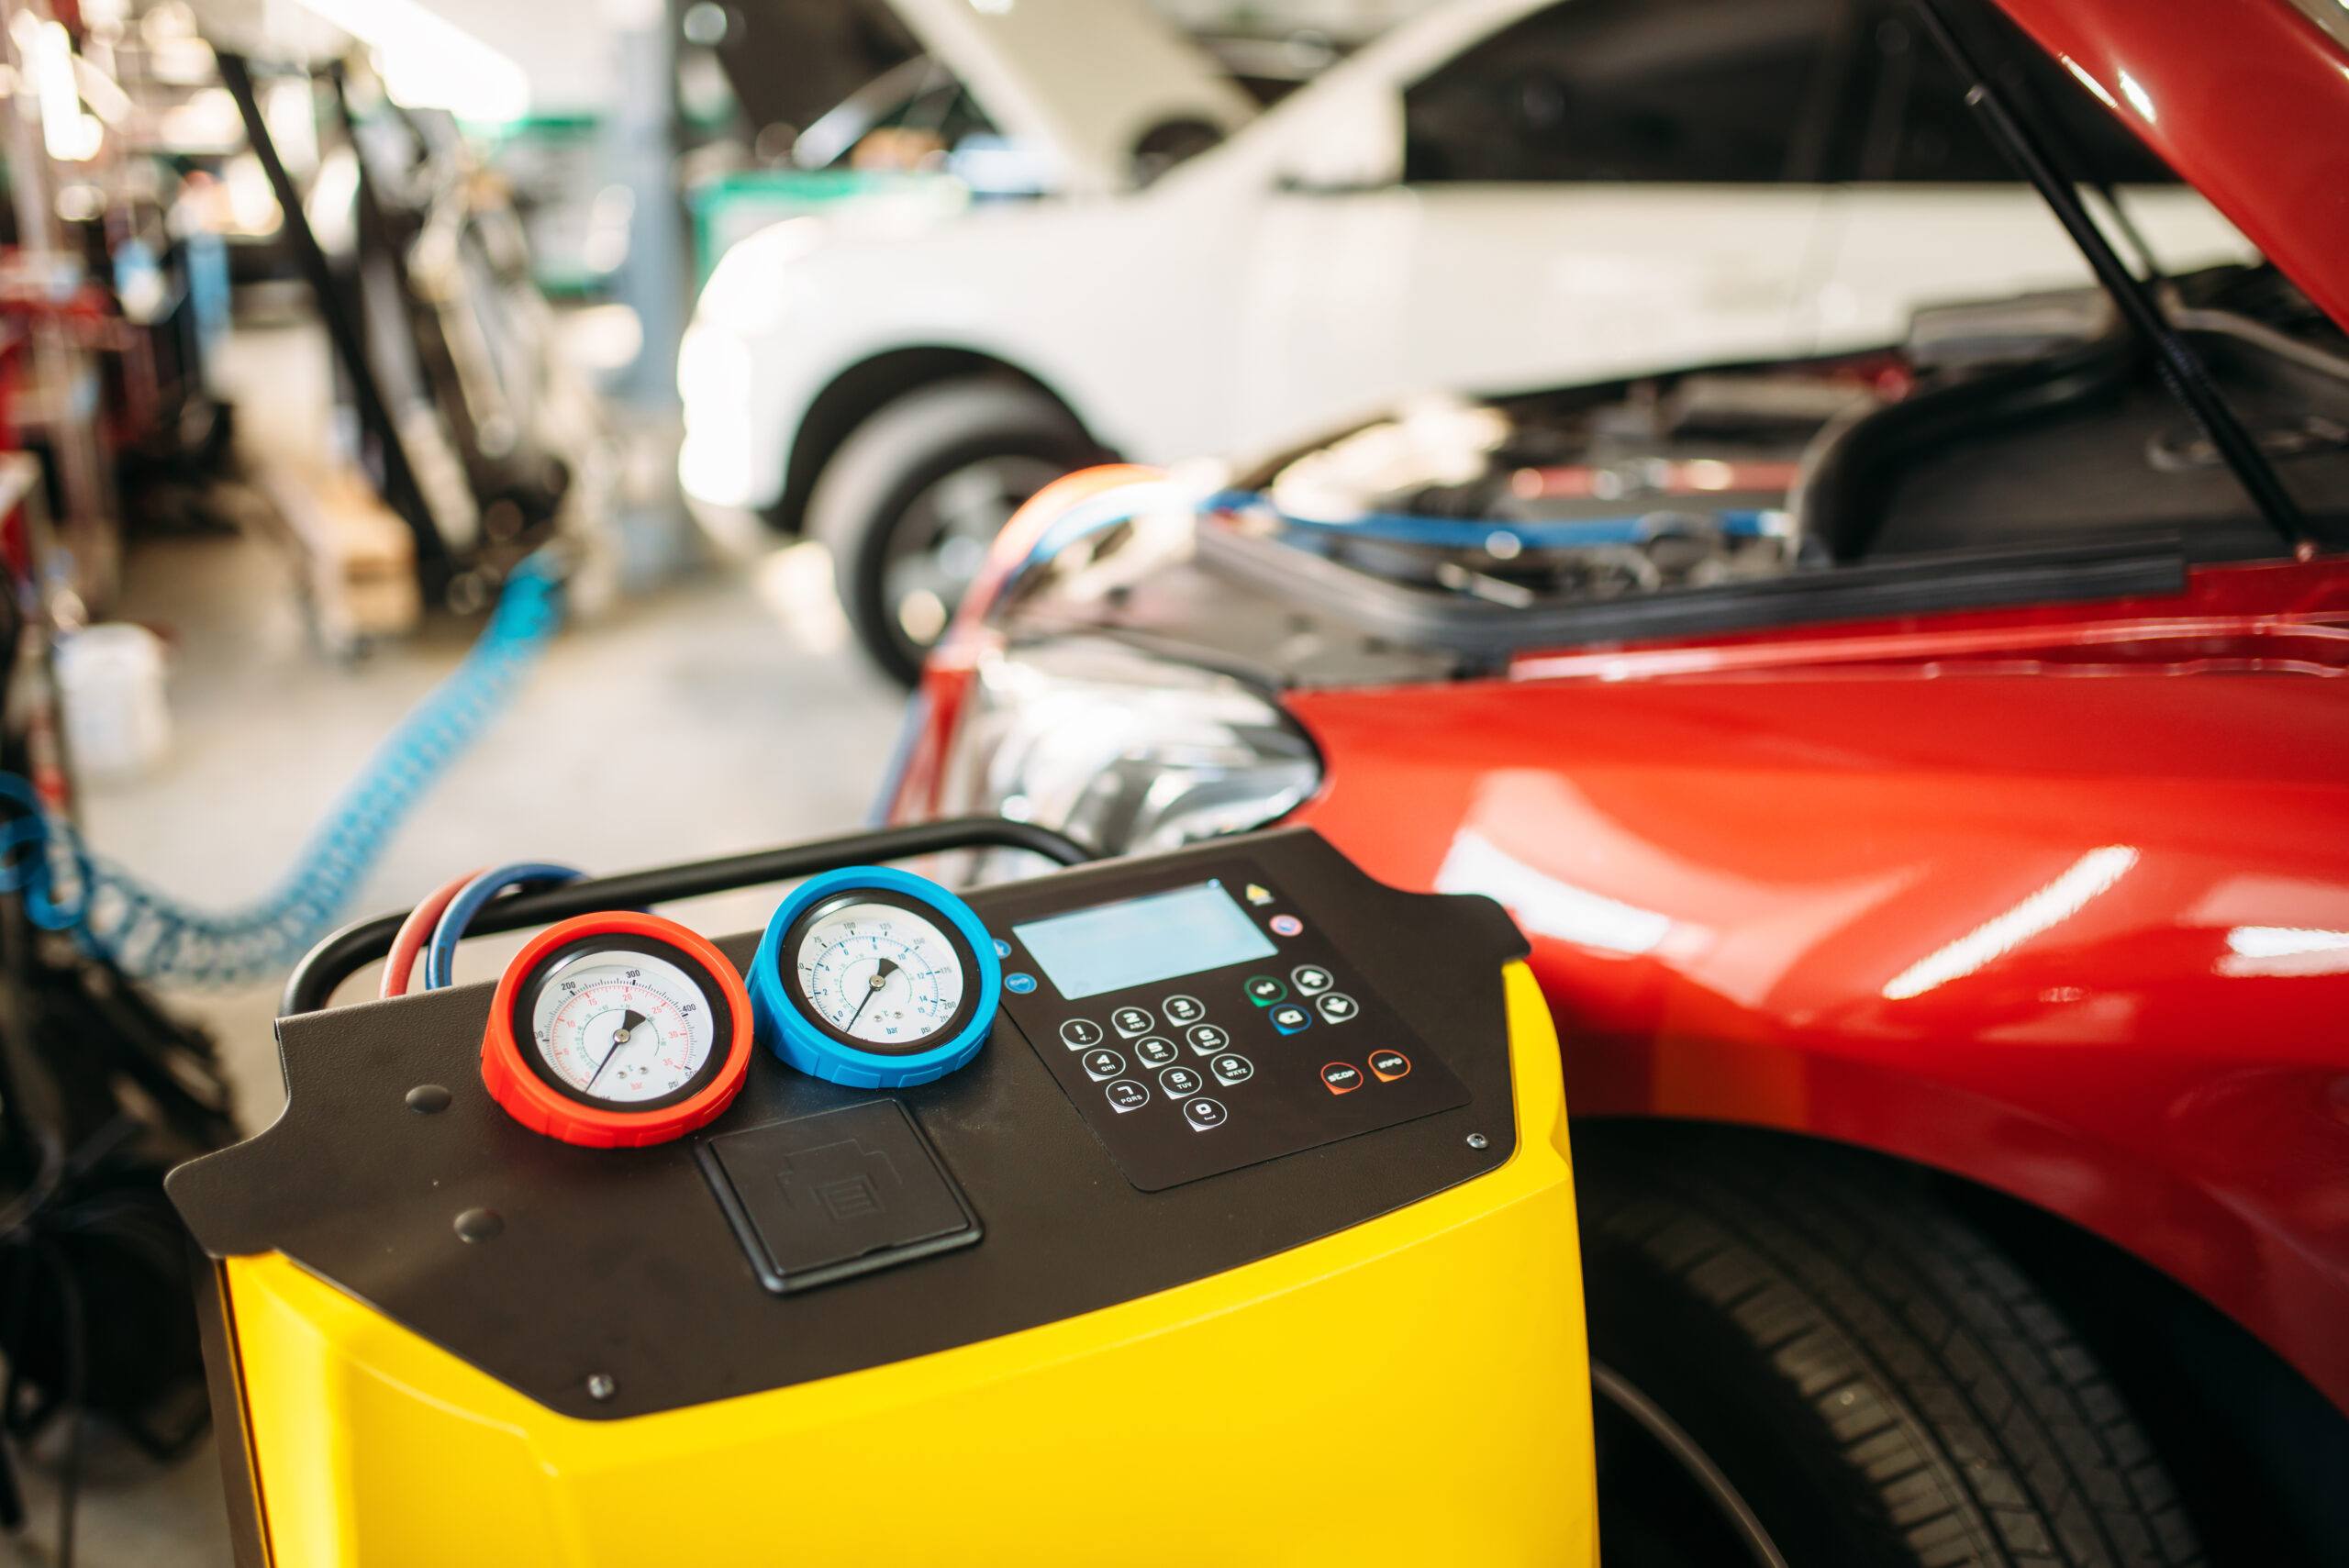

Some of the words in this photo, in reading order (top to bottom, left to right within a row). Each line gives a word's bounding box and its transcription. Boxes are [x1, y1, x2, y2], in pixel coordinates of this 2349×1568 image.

[879, 922, 892, 930] 125
[626, 969, 640, 979] 300
[940, 966, 952, 974] 175
[561, 981, 576, 991] 200
[823, 988, 828, 996] 2
[588, 997, 598, 1006] 15
[622, 994, 633, 1002] 20
[651, 1006, 662, 1014] 25
[682, 1003, 696, 1012] 400
[943, 1002, 956, 1010] 200
[1174, 1000, 1190, 1012] 3
[1123, 1012, 1141, 1023] 2
[566, 1019, 576, 1028] 10
[668, 1030, 679, 1039] 30
[885, 1027, 898, 1035] bar
[920, 1026, 931, 1035] psi
[1074, 1025, 1084, 1035] 1
[1198, 1029, 1214, 1040] 6
[1146, 1041, 1163, 1053] 5
[662, 1058, 674, 1066] 35
[1097, 1054, 1110, 1064] 4
[1222, 1059, 1239, 1071] 9
[1226, 1067, 1248, 1077] WXYZ
[1171, 1072, 1187, 1083] 8
[668, 1078, 680, 1090] psi
[1117, 1085, 1134, 1095] 7
[1120, 1095, 1142, 1104] PQRS
[1195, 1103, 1211, 1115] 0
